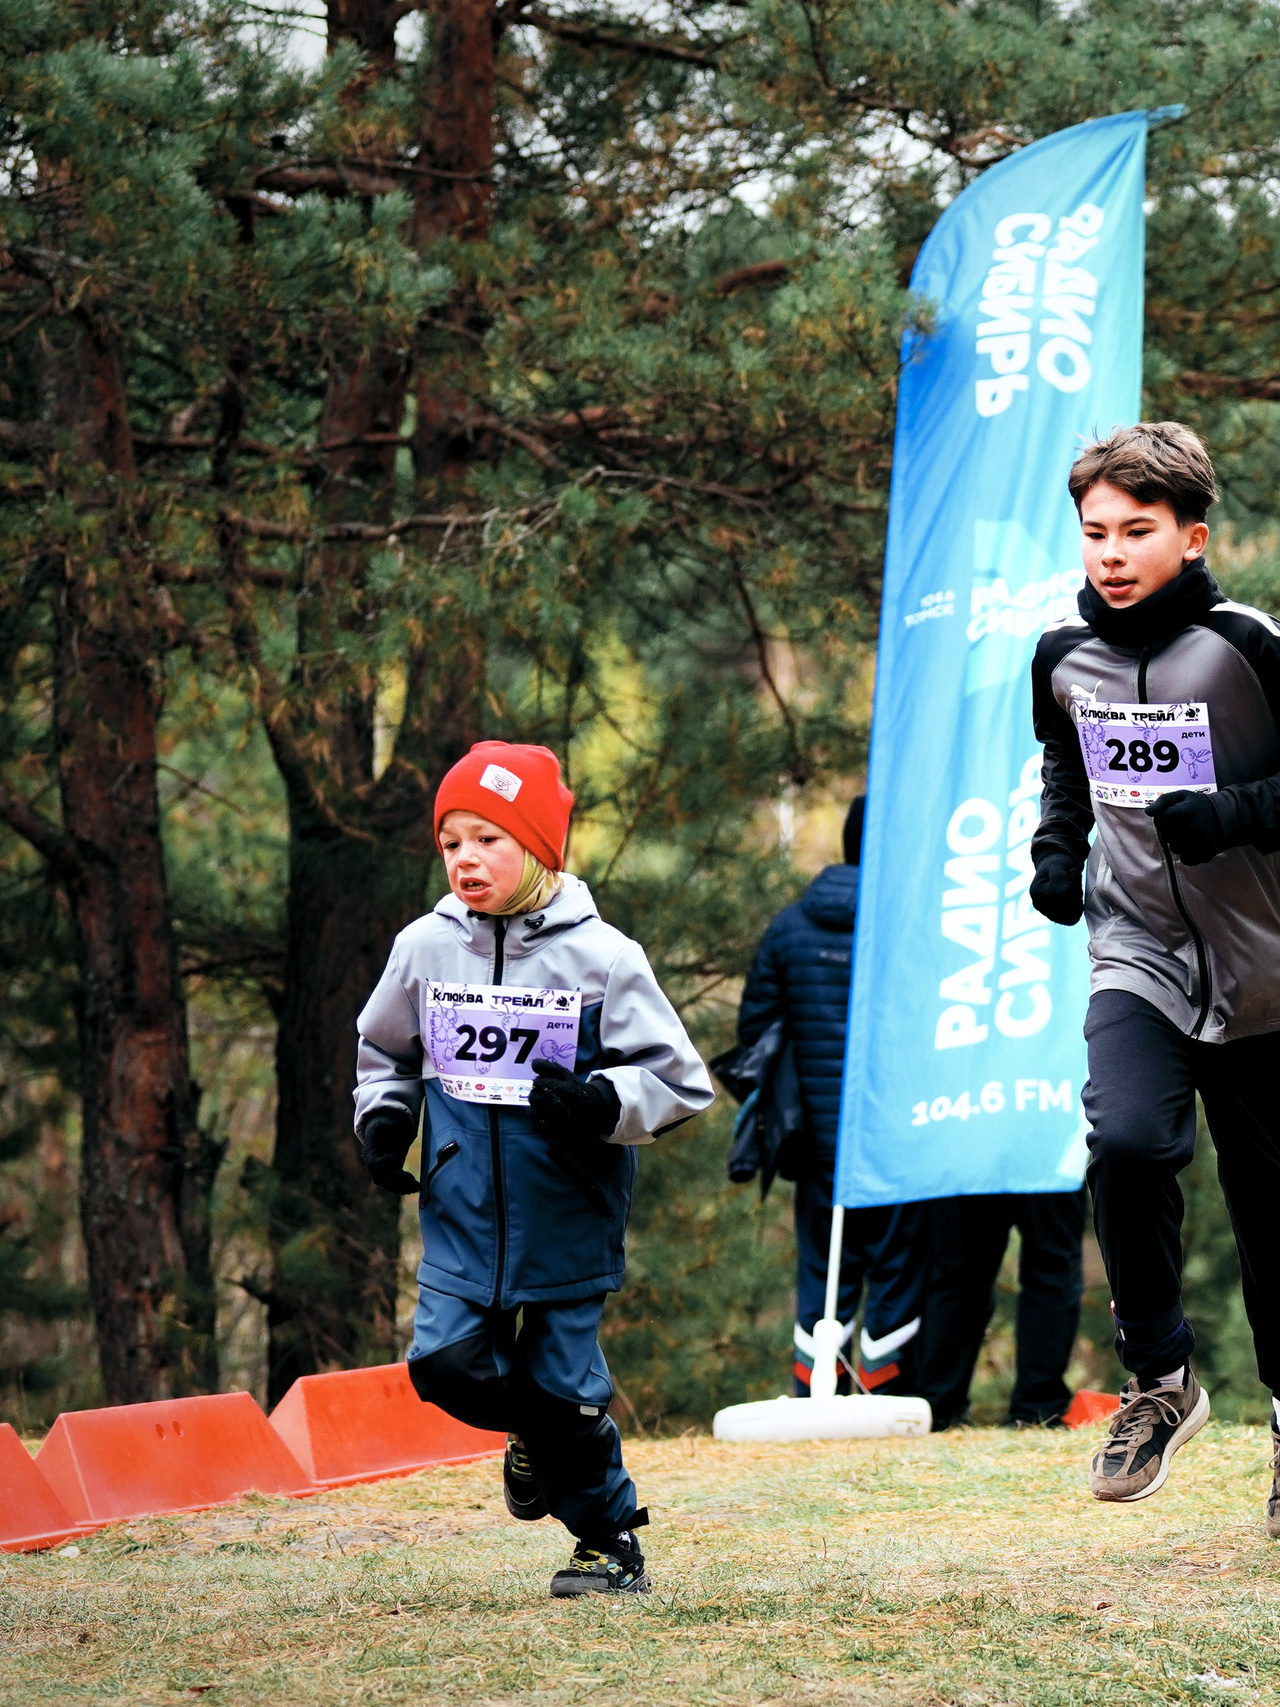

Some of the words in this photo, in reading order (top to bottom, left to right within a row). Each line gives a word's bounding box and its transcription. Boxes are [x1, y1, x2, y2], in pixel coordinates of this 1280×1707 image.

[975, 212, 1052, 417] СИБИРЬ
[1036, 203, 1104, 393] РАДИО
[1080, 709, 1127, 721] КЛЮКВА
[1132, 710, 1175, 721] ТРЕЙЛ
[1181, 731, 1205, 739] дети
[1105, 738, 1179, 773] 289
[934, 798, 1003, 1050] РАДИО
[433, 991, 484, 1004] КЛЮКВА
[491, 994, 544, 1008] ТРЕЙЛ
[455, 1024, 540, 1065] 297
[546, 1021, 573, 1030] дети
[911, 1080, 1002, 1126] 104.6
[1014, 1079, 1073, 1112] FM
